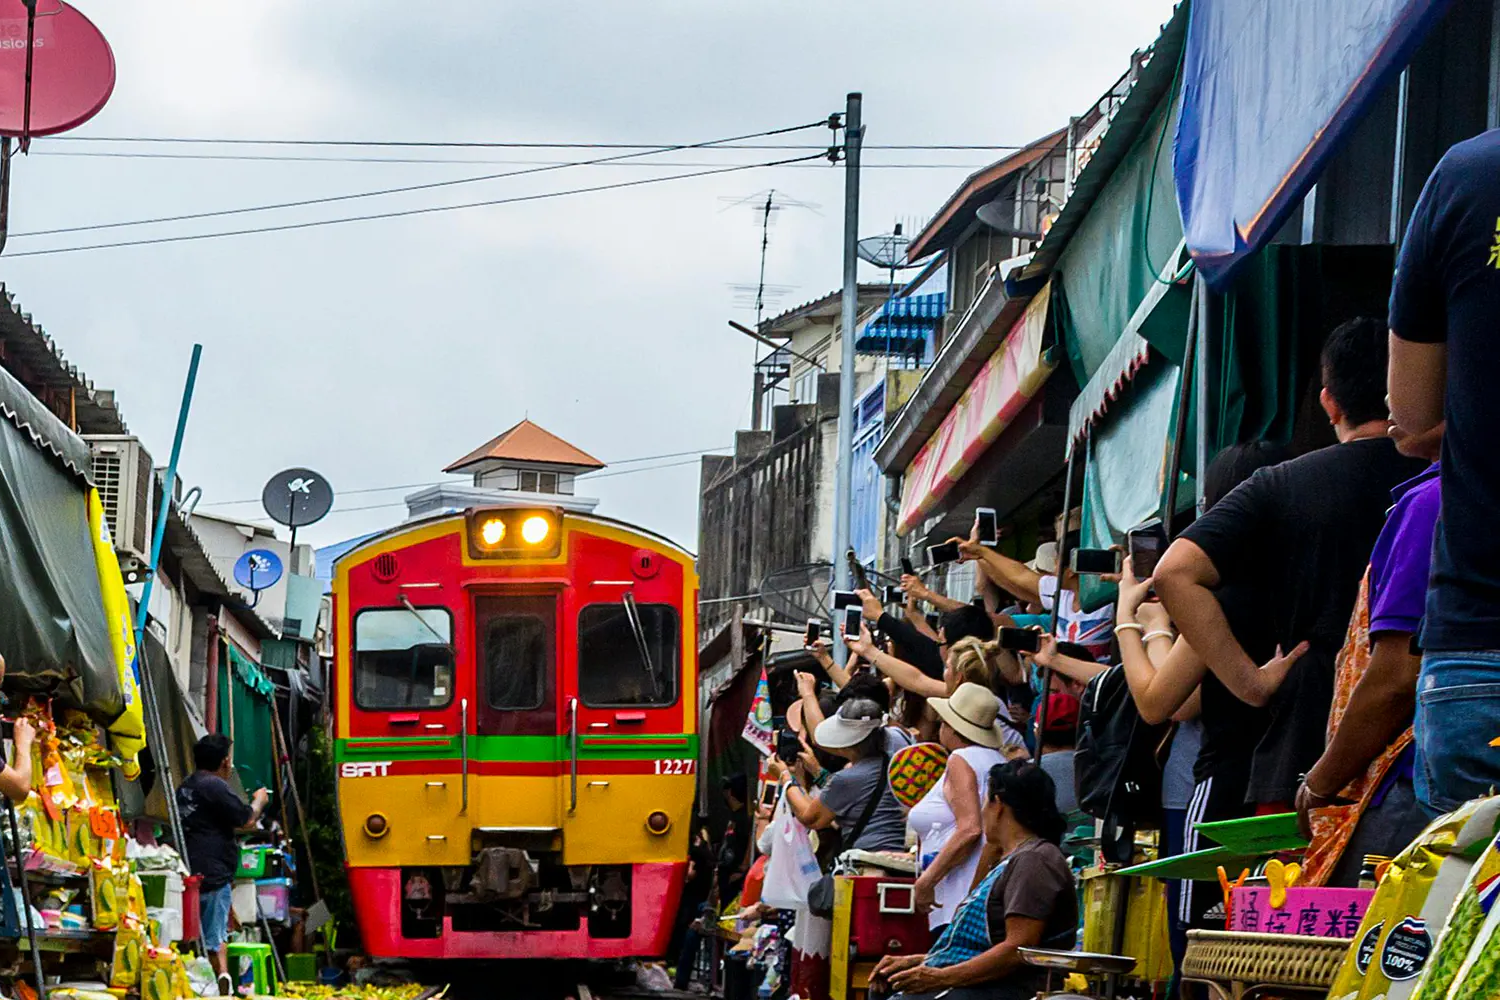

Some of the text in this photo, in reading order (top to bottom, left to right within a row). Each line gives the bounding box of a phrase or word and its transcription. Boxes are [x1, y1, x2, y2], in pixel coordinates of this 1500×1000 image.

[341, 762, 392, 778] SRT
[653, 759, 692, 775] 1227
[1385, 954, 1416, 972] 100%
